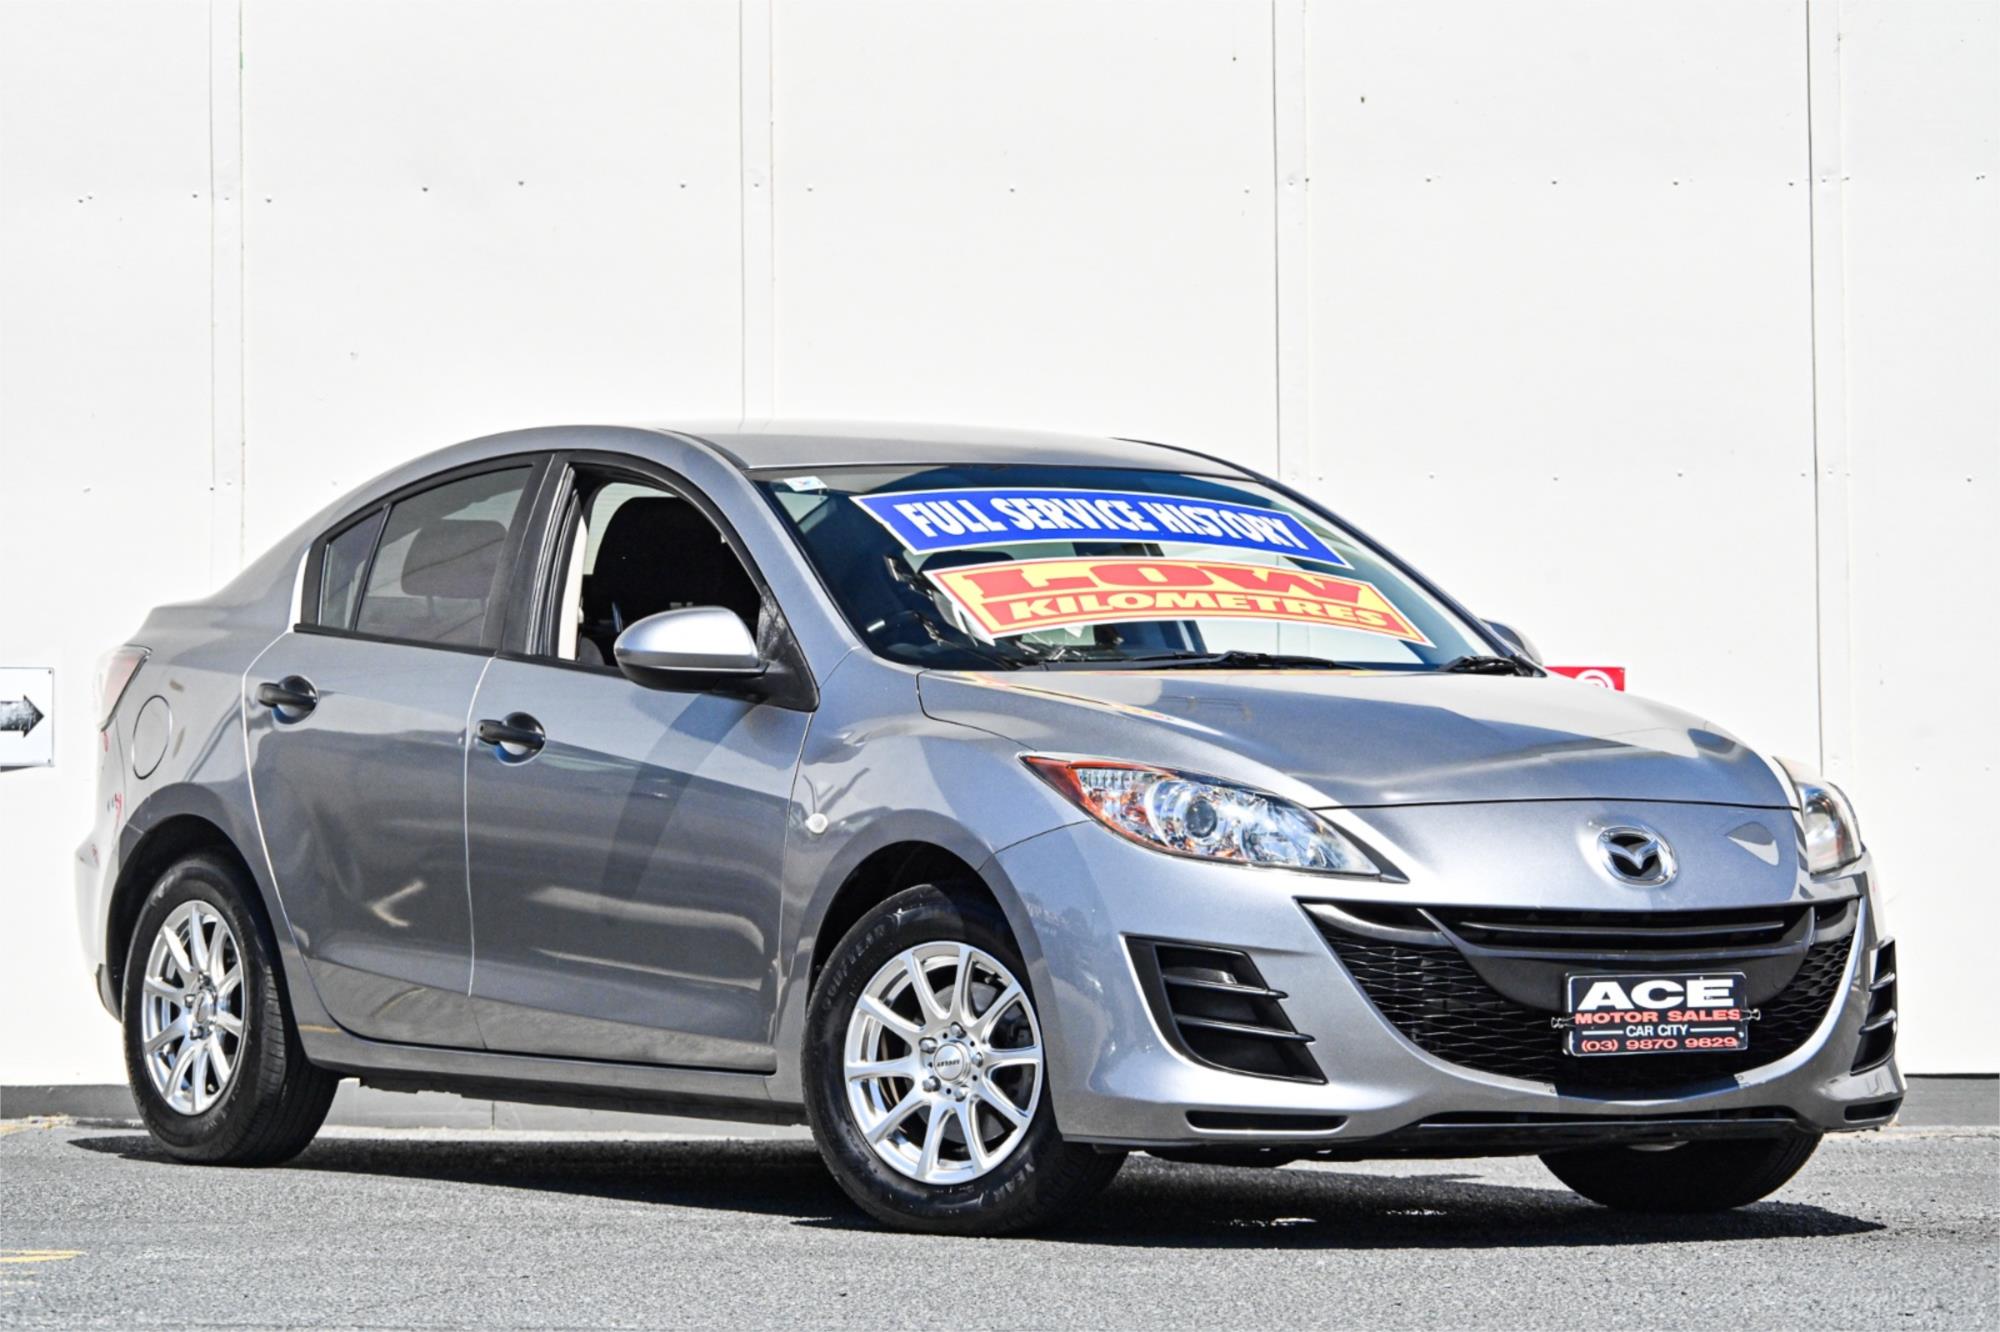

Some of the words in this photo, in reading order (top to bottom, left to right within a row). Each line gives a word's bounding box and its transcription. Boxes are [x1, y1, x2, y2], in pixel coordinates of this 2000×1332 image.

[893, 498, 1007, 538] FULL
[989, 497, 1158, 533] SERVICE
[1138, 501, 1309, 550] HISTORY
[963, 563, 1362, 604] LOW
[1008, 592, 1388, 626] KILOMETRES
[1577, 978, 1734, 1011] ACE
[1574, 1011, 1659, 1025] MOTOR
[1667, 1009, 1741, 1022] SALES
[1625, 1025, 1654, 1037] CAR
[1657, 1024, 1690, 1036] CITY
[1580, 1039, 1618, 1052] (03)
[1626, 1038, 1677, 1050] 9870
[1684, 1037, 1738, 1049] 9829
